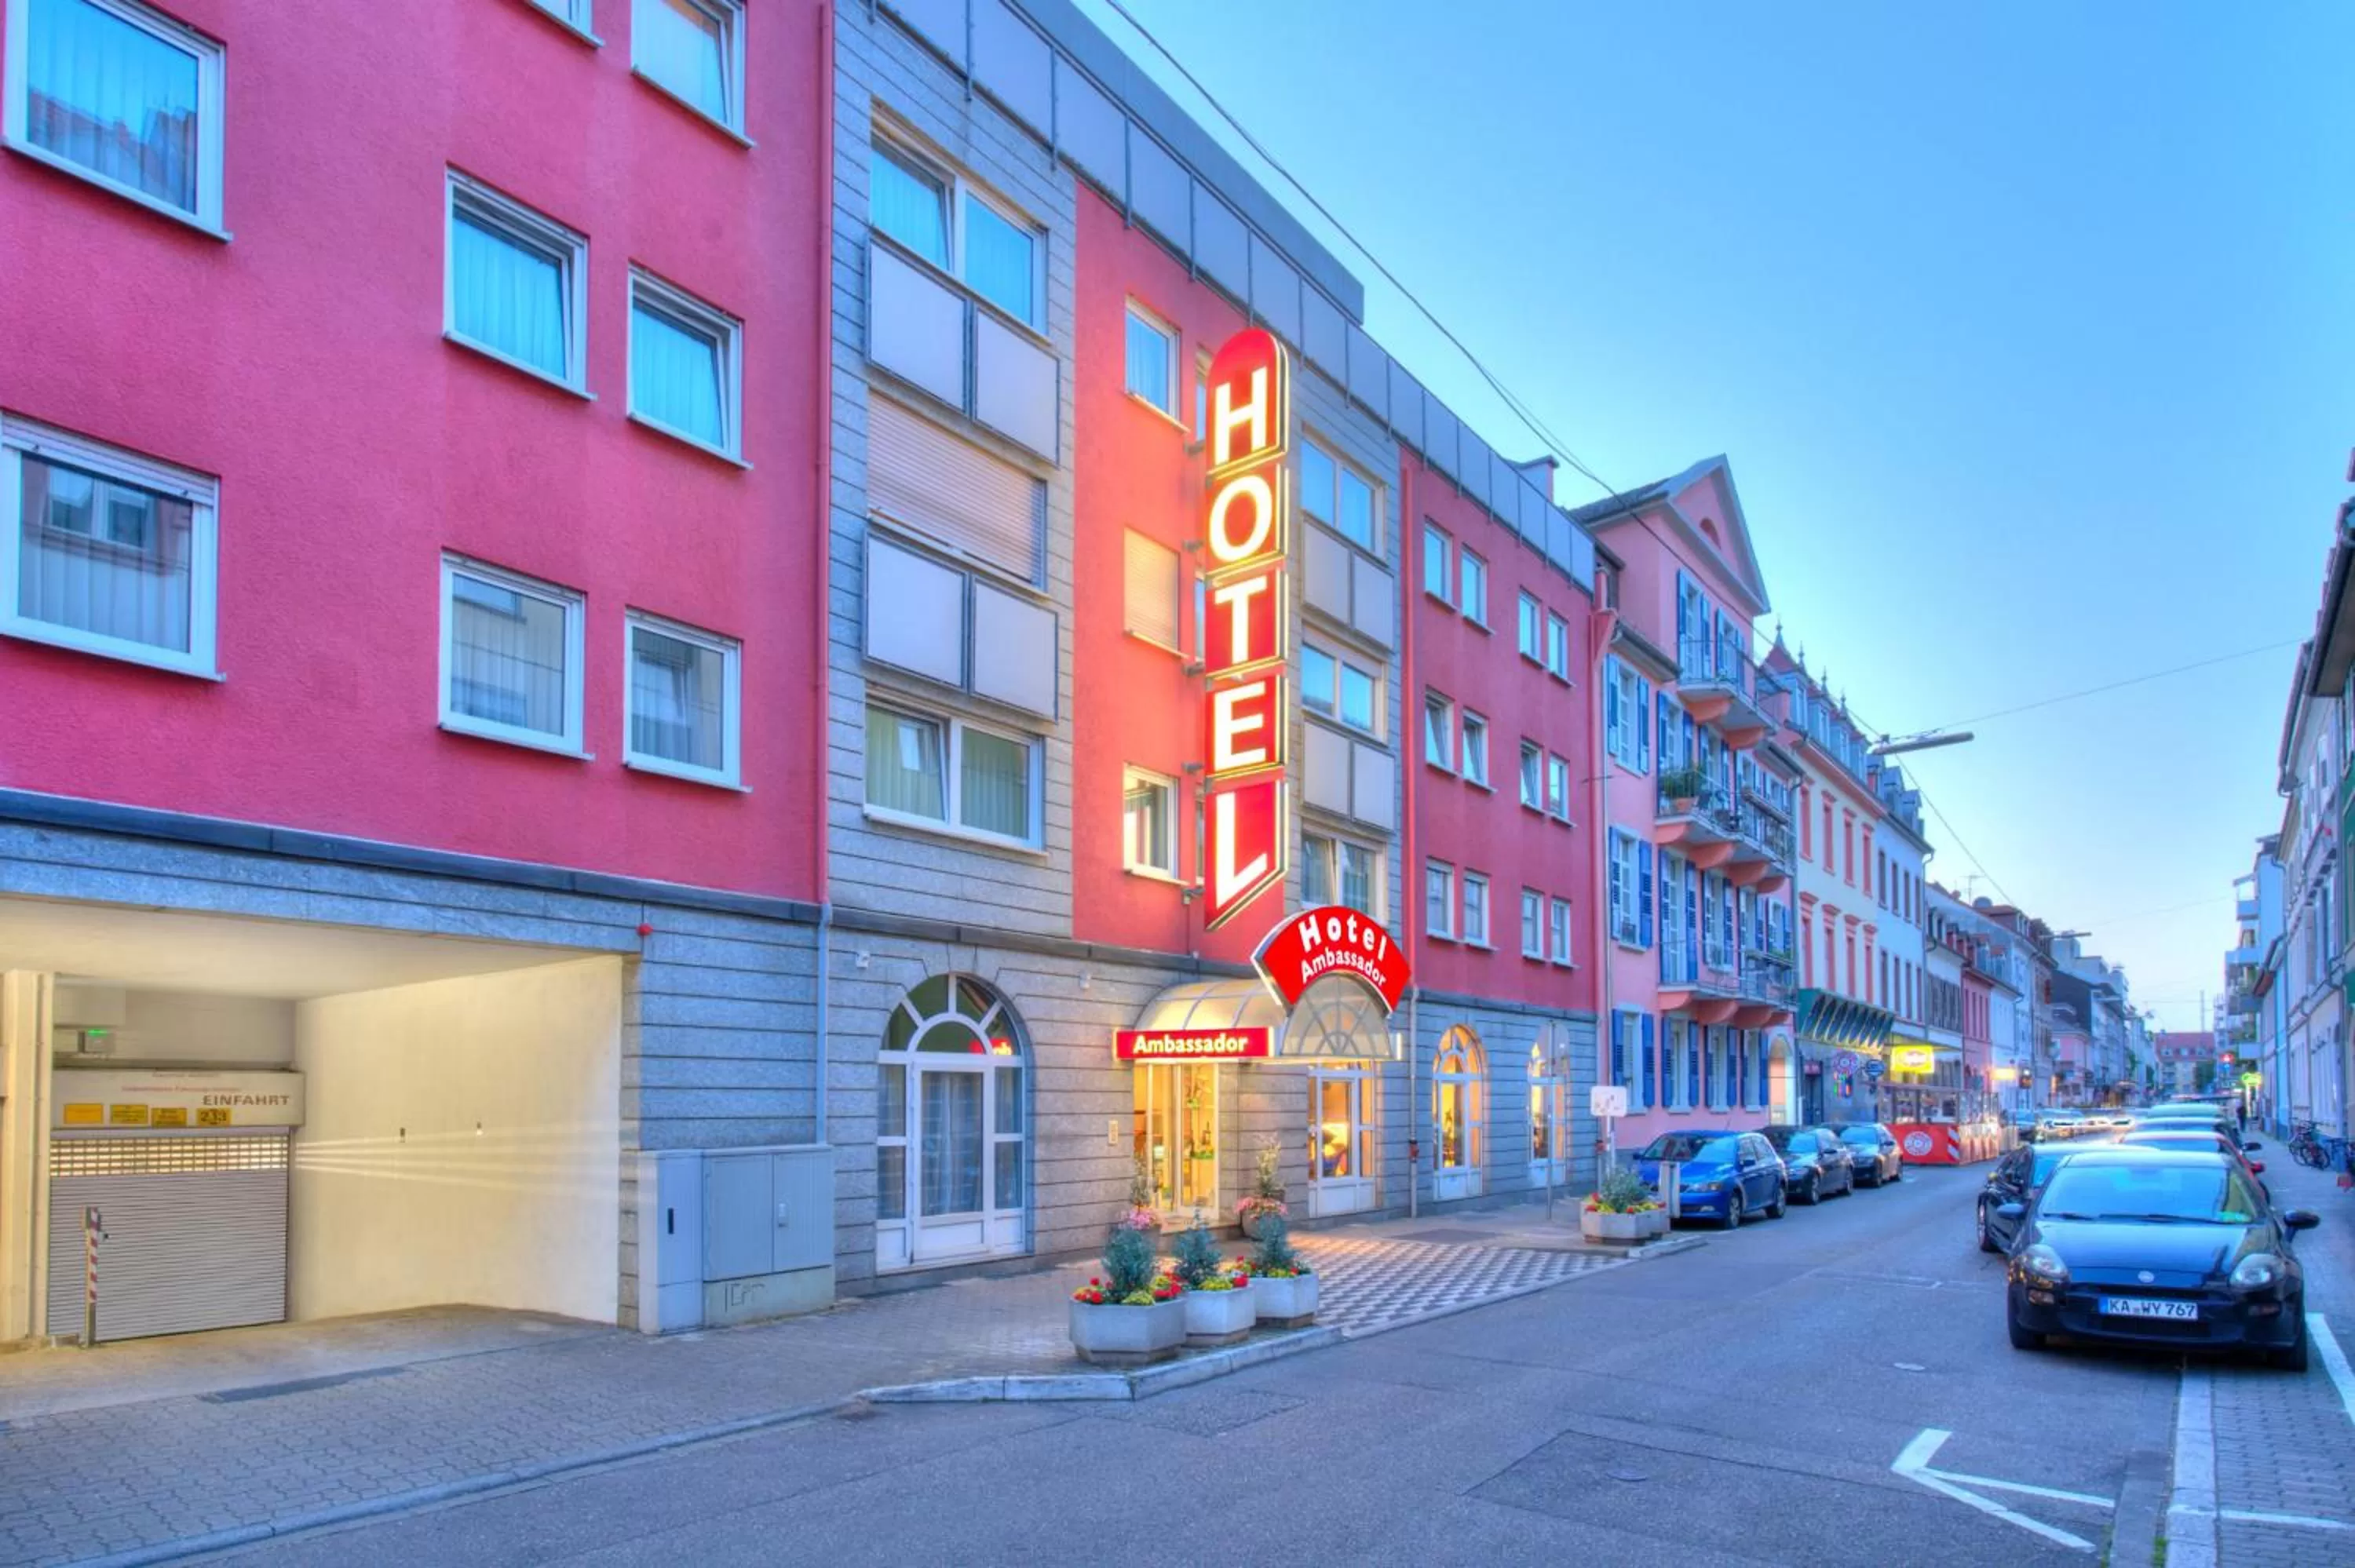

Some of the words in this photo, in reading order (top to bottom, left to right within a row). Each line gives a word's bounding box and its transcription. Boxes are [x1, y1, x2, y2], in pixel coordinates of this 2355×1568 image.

[1210, 366, 1273, 909] HOTEL
[1298, 913, 1387, 962] Hotel
[1301, 946, 1387, 985] Ambassador
[1133, 1033, 1248, 1054] Ambassador
[202, 1095, 290, 1106] EINFAHRT
[2109, 1299, 2130, 1313] KA
[2165, 1304, 2196, 1317] 767
